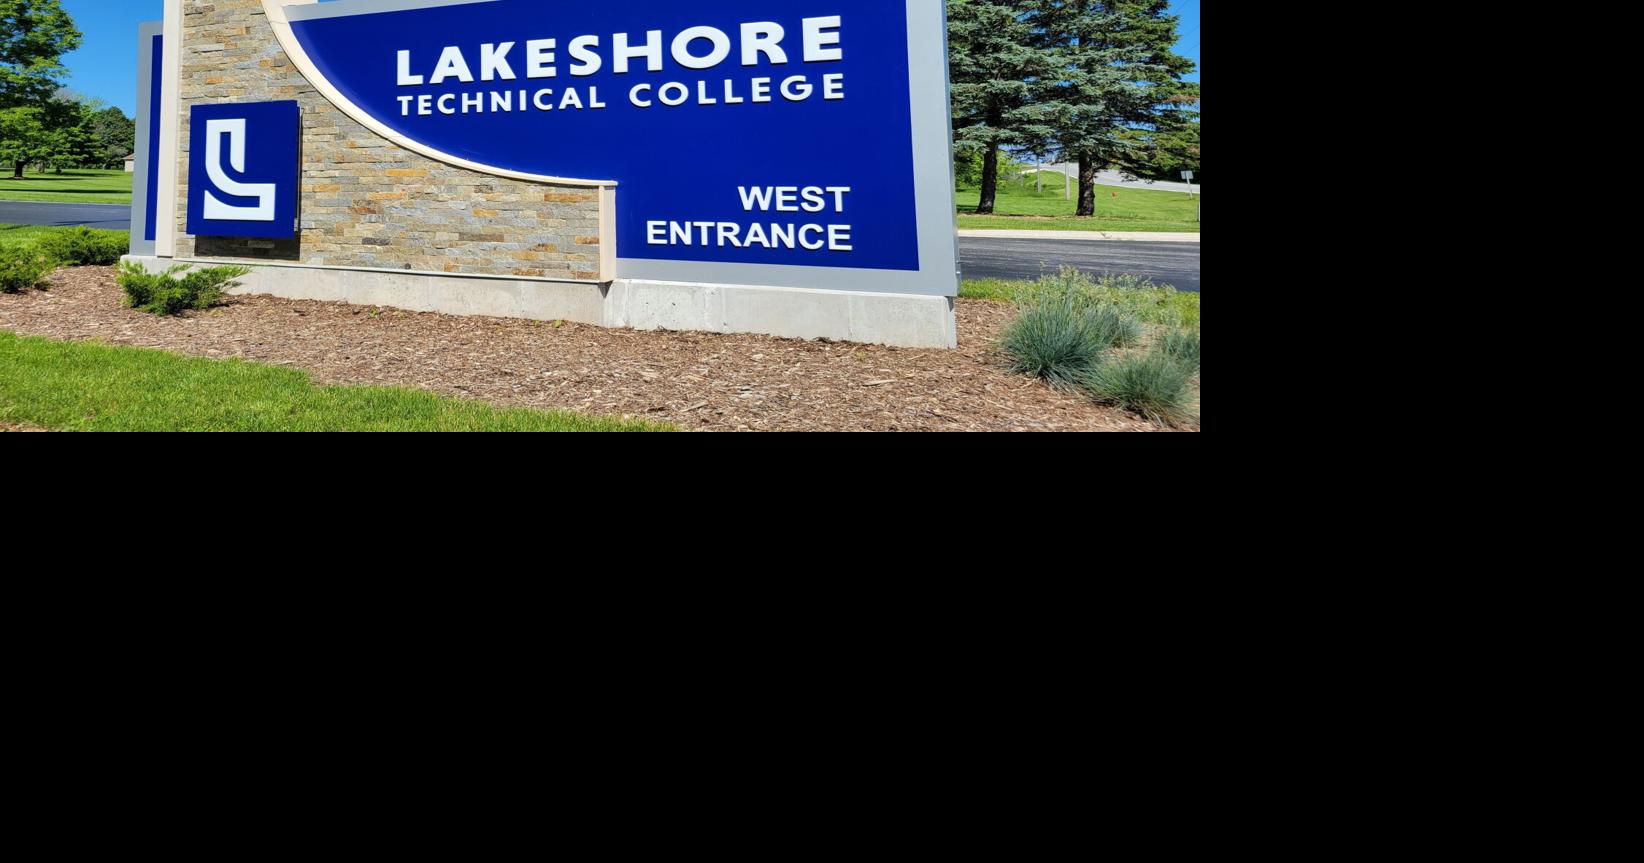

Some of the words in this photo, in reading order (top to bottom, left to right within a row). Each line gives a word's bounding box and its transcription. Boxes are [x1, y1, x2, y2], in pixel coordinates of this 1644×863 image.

[396, 15, 844, 86] LAKESHORE
[397, 86, 607, 116] TECHNICAL
[629, 73, 845, 108] COLLEGE
[738, 185, 851, 212] WEST
[645, 220, 853, 251] ENTRANCE
